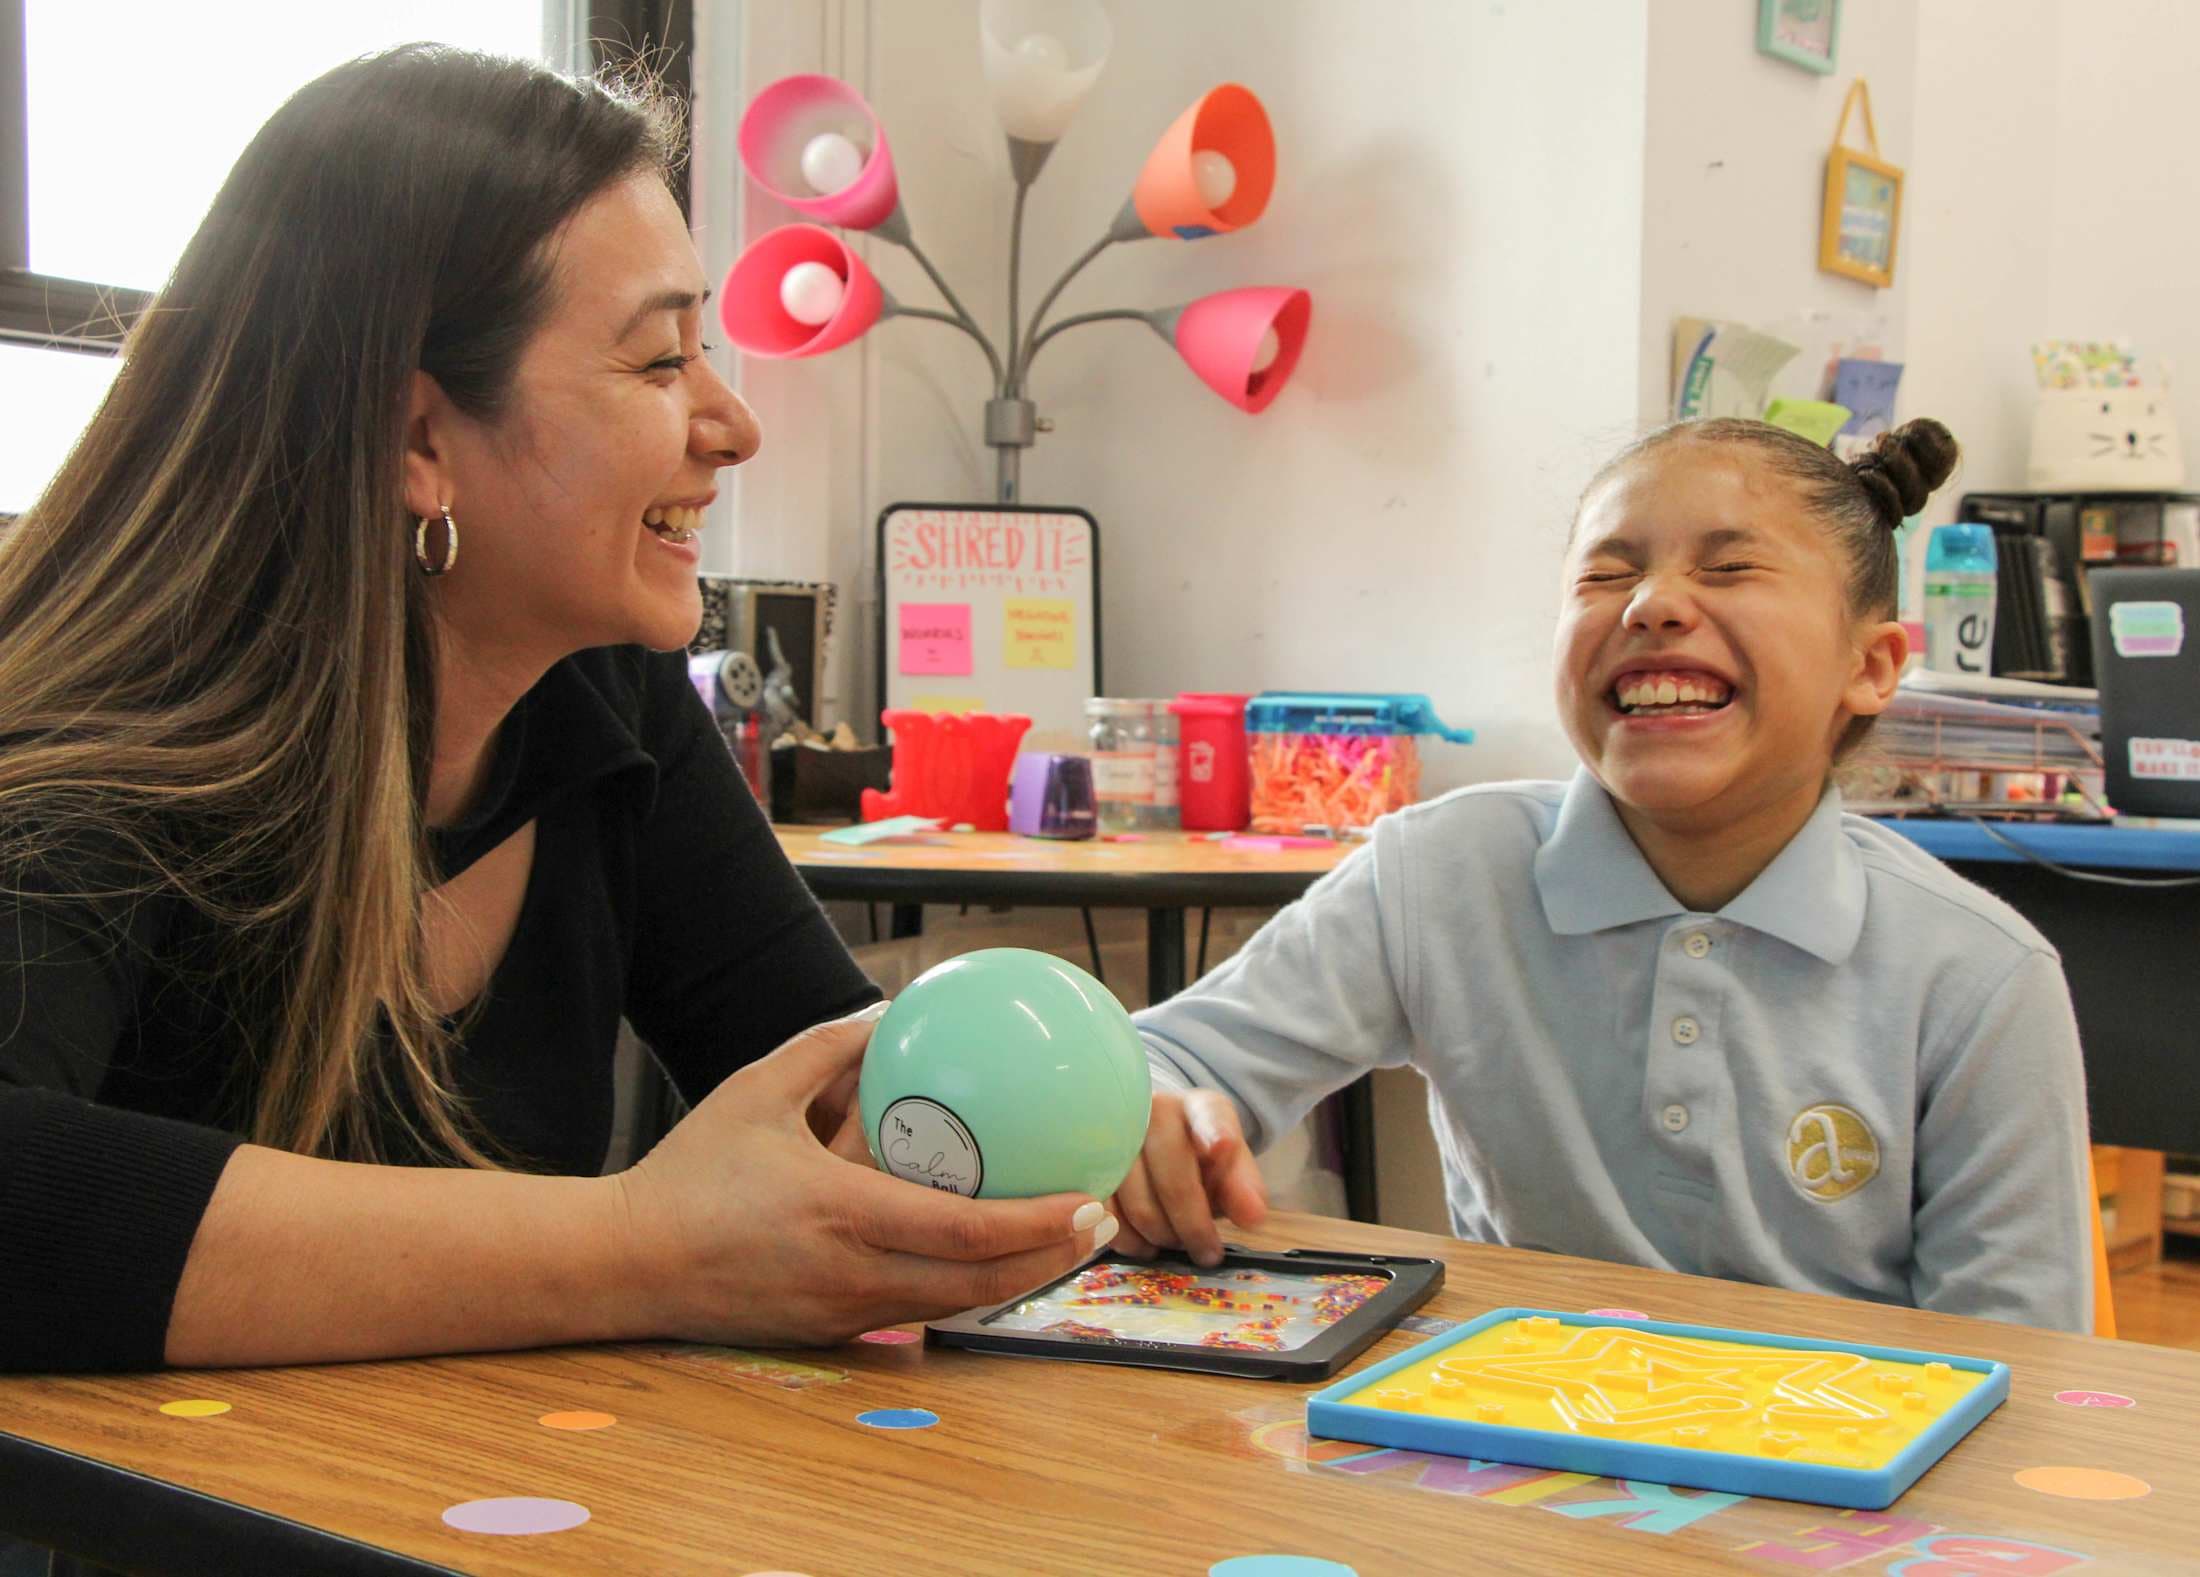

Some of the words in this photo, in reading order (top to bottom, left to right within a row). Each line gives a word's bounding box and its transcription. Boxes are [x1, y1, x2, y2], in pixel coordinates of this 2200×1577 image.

[909, 522, 1025, 571] SHRED
[1033, 526, 1064, 573] IT
[894, 1116, 913, 1137] The
[889, 1137, 967, 1181] Calm
